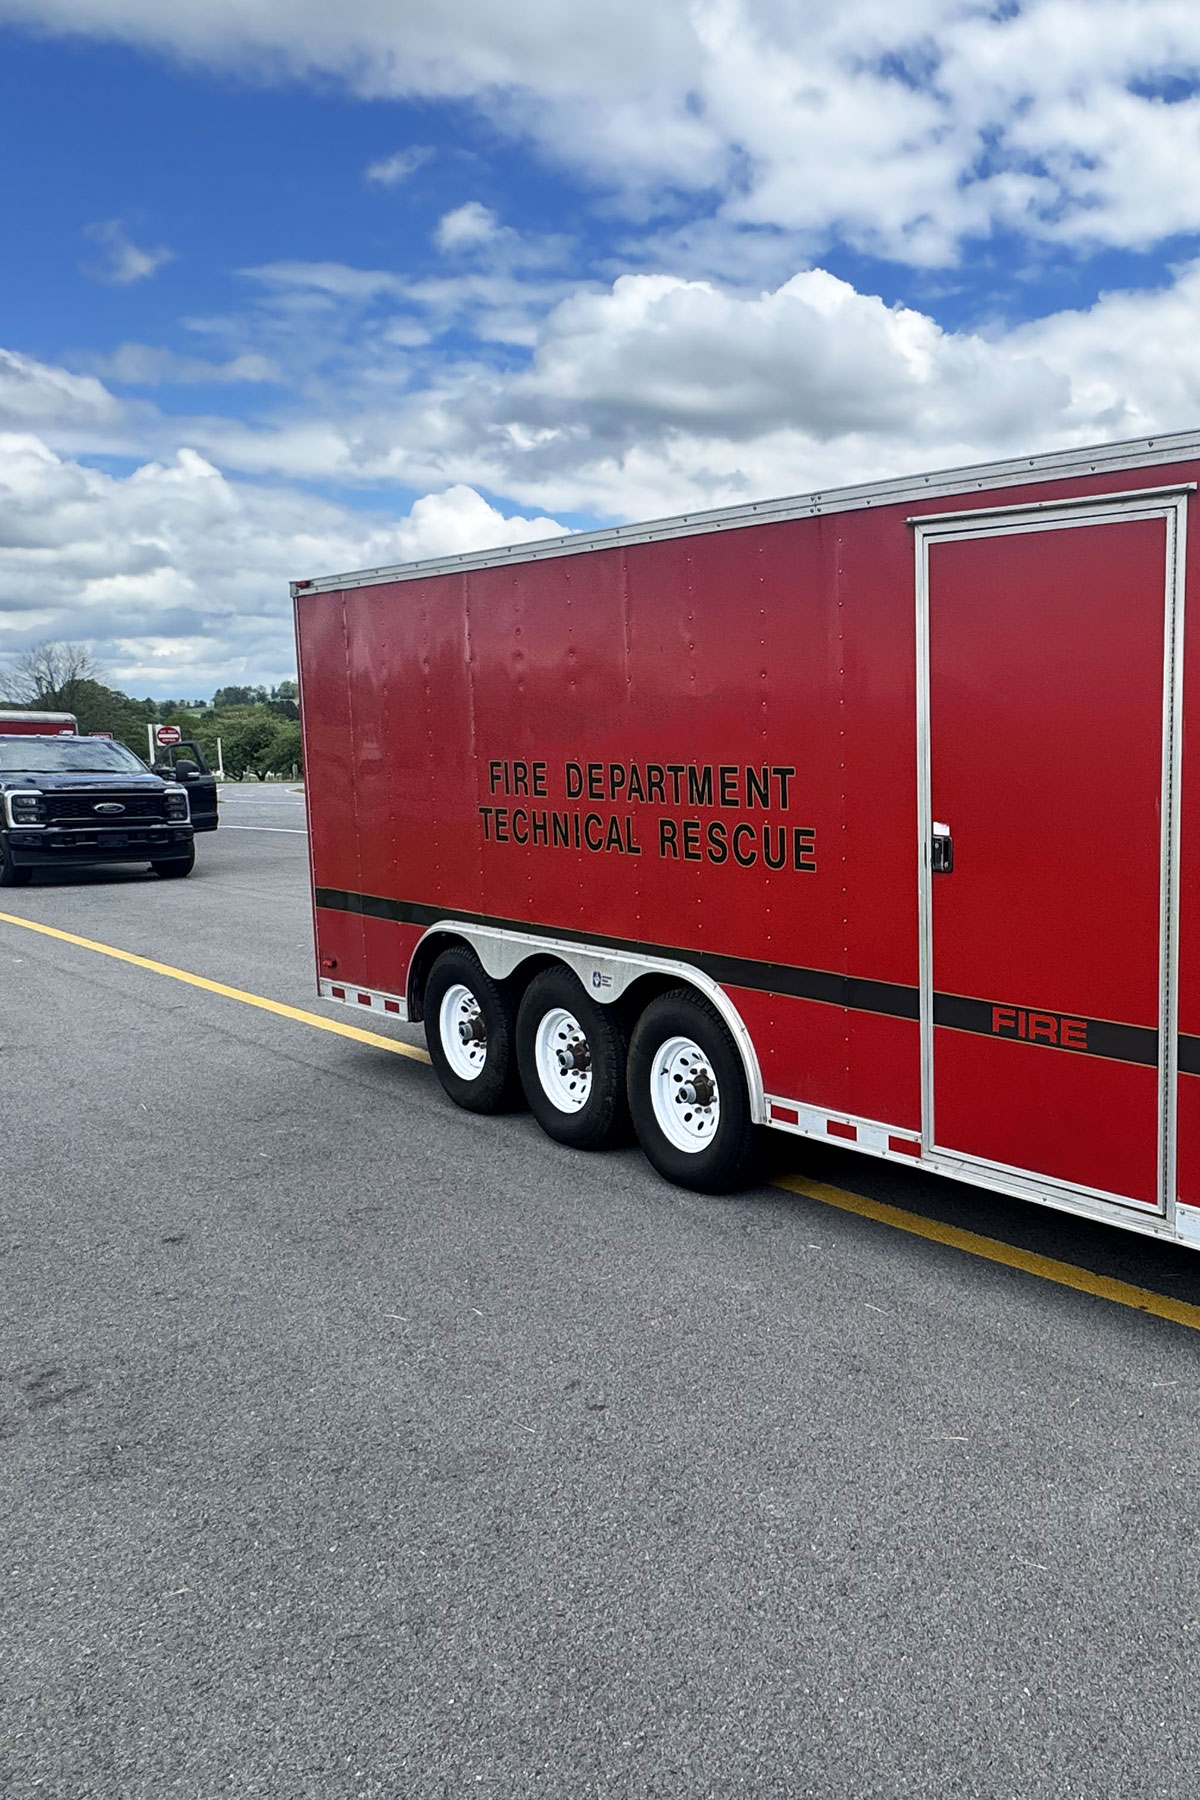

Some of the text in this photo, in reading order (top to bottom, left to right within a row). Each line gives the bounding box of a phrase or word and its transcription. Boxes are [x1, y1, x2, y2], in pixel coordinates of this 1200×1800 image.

[488, 760, 796, 810] FIRE DEPARTMENT
[478, 806, 817, 873] TECHNICAL RESCUE
[992, 1006, 1087, 1049] FIRE
